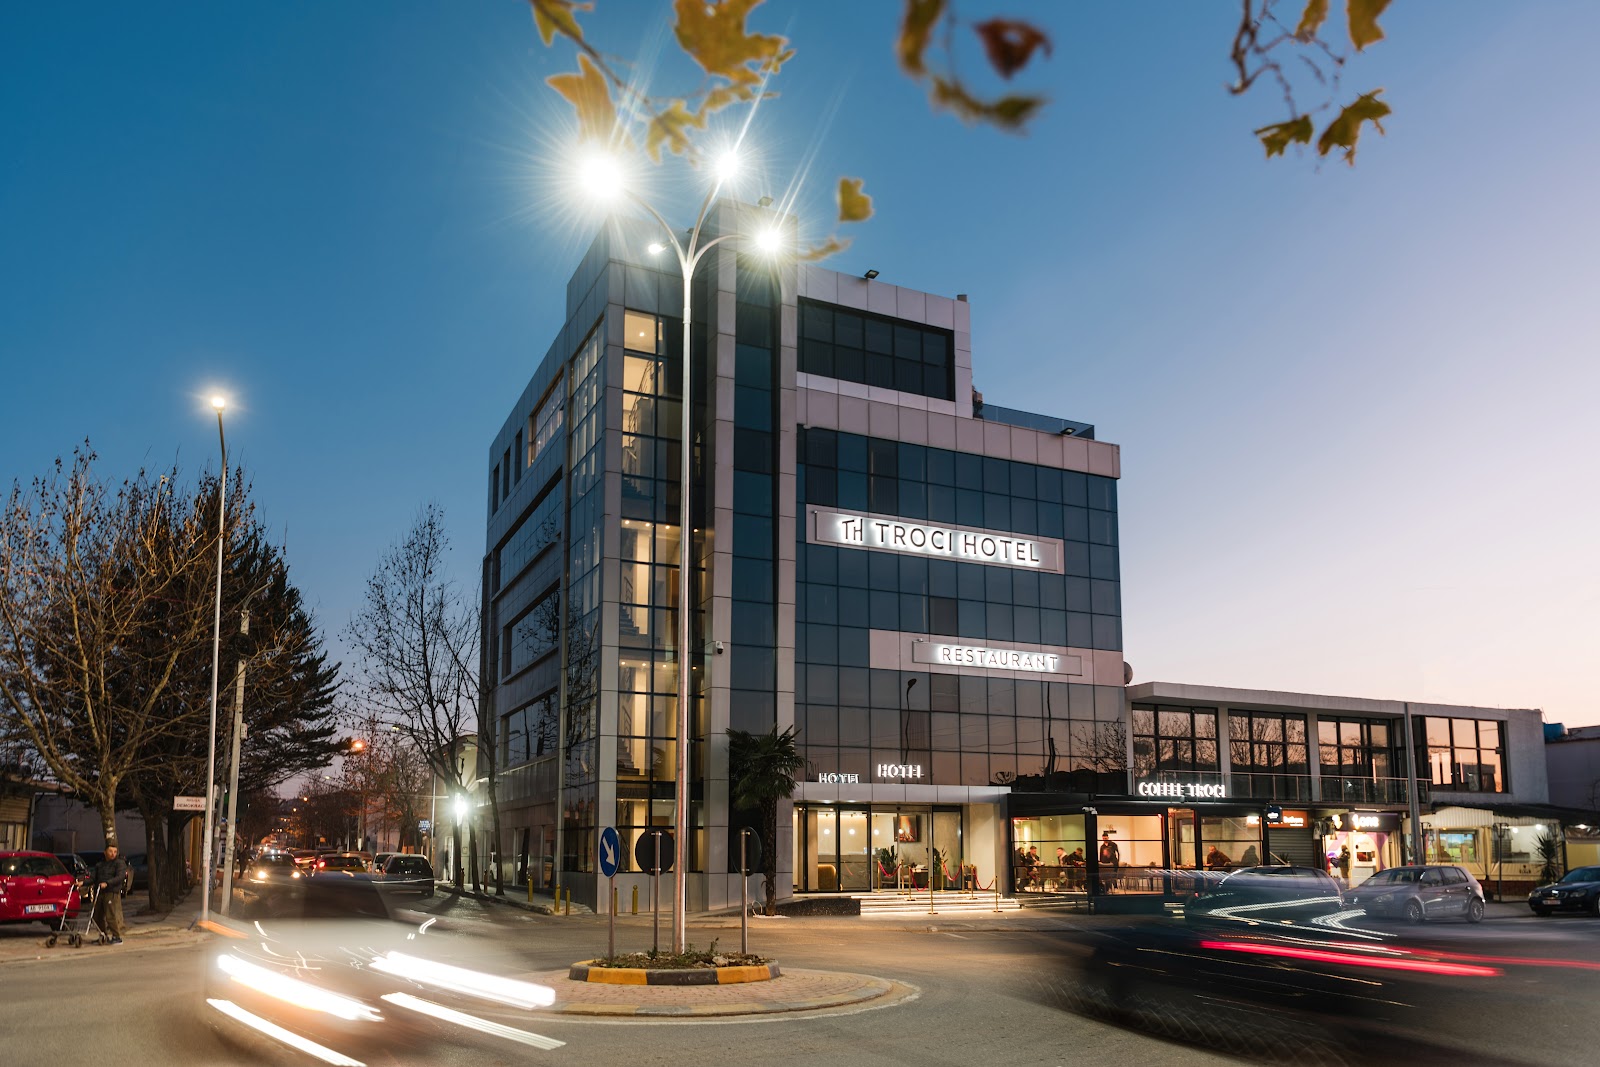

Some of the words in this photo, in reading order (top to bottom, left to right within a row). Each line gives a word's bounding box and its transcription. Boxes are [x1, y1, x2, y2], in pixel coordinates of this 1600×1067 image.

[875, 522, 952, 552] TROCI
[964, 534, 1040, 563] HOTEL
[942, 647, 1058, 670] RESTAURANT
[877, 763, 925, 779] HOTEL
[1138, 781, 1185, 797] COFFEE
[1186, 783, 1226, 798] TROCI
